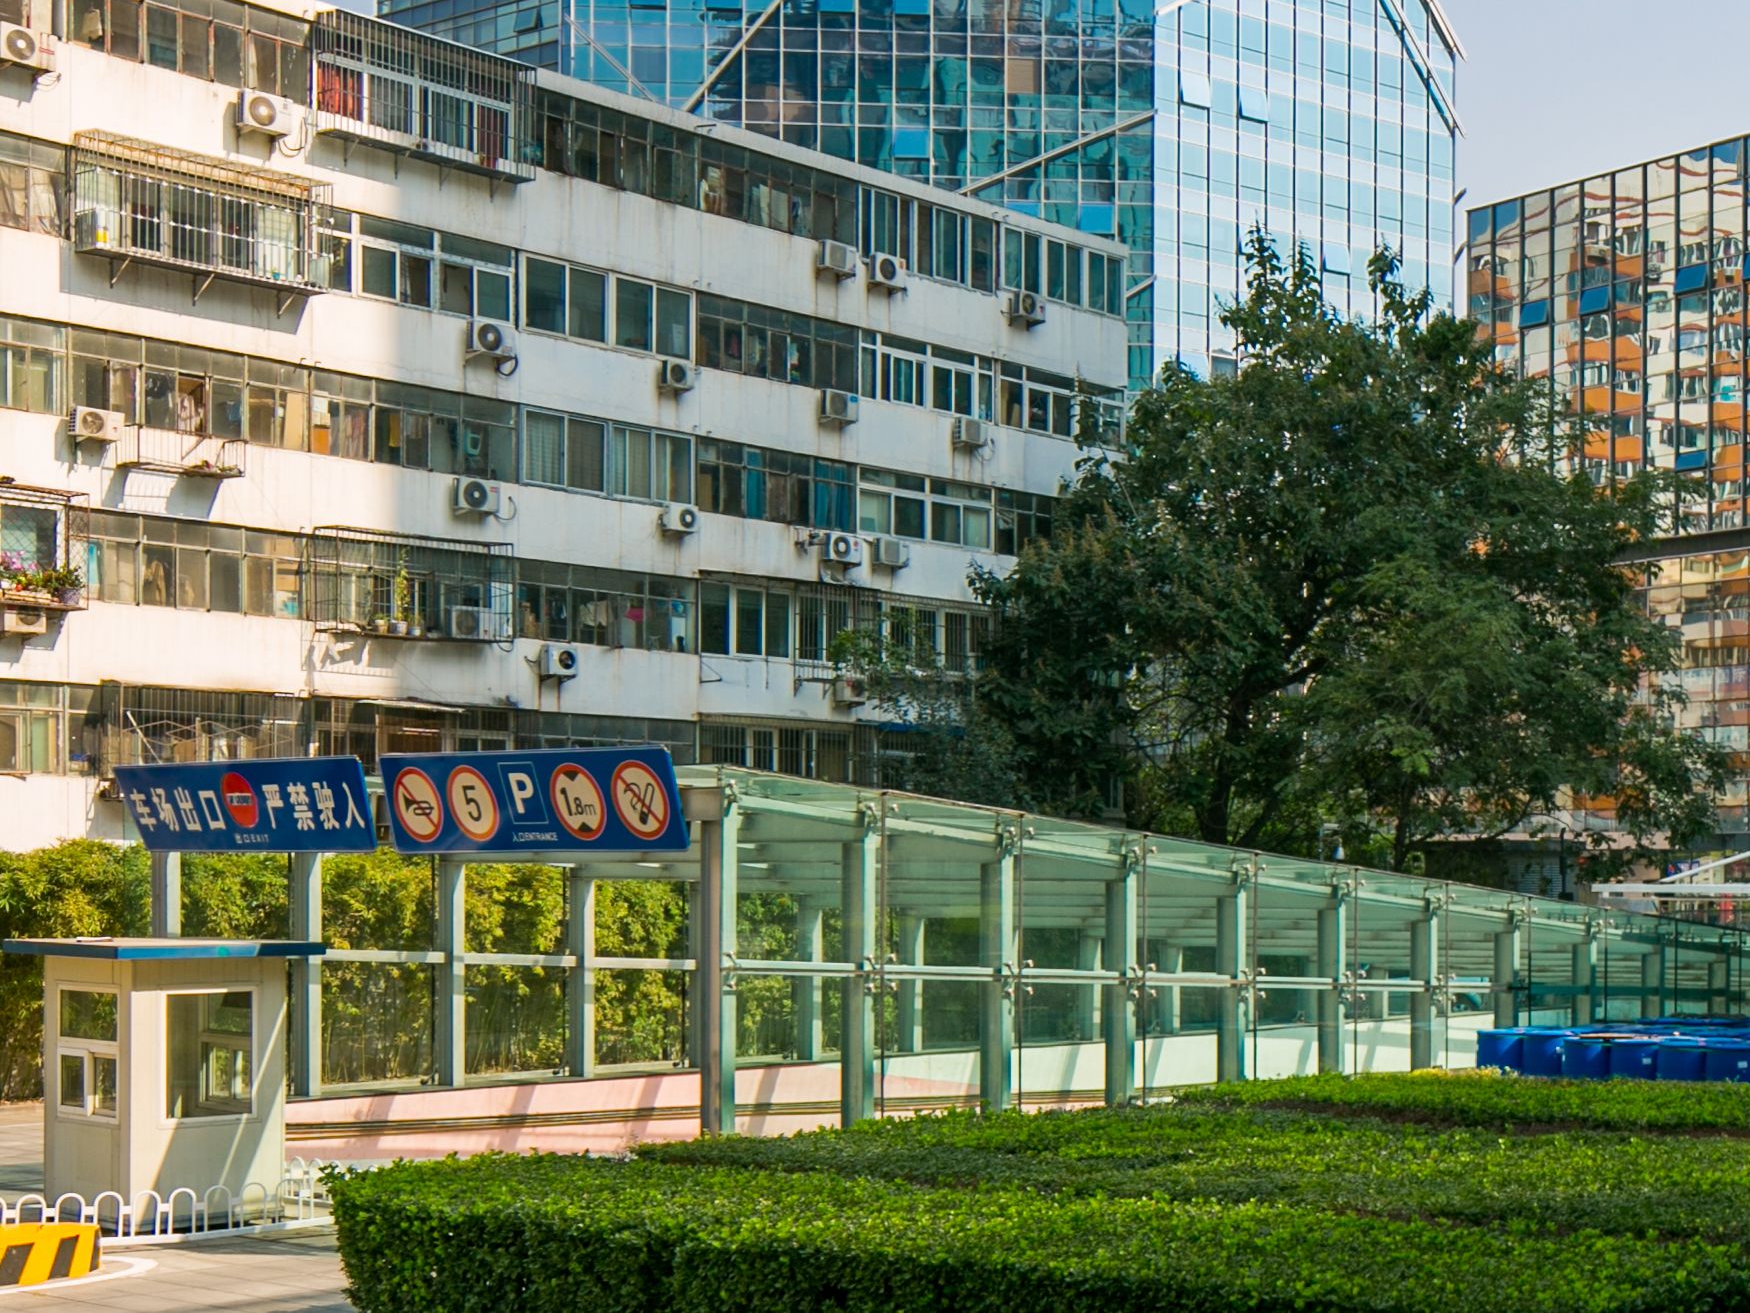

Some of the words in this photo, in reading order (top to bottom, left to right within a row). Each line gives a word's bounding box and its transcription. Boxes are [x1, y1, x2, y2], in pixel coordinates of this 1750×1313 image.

[129, 787, 226, 831] 车场出口
[262, 781, 365, 830] 严禁驶入
[462, 785, 482, 822] 5
[507, 772, 534, 814] P
[560, 787, 596, 816] 1.8m
